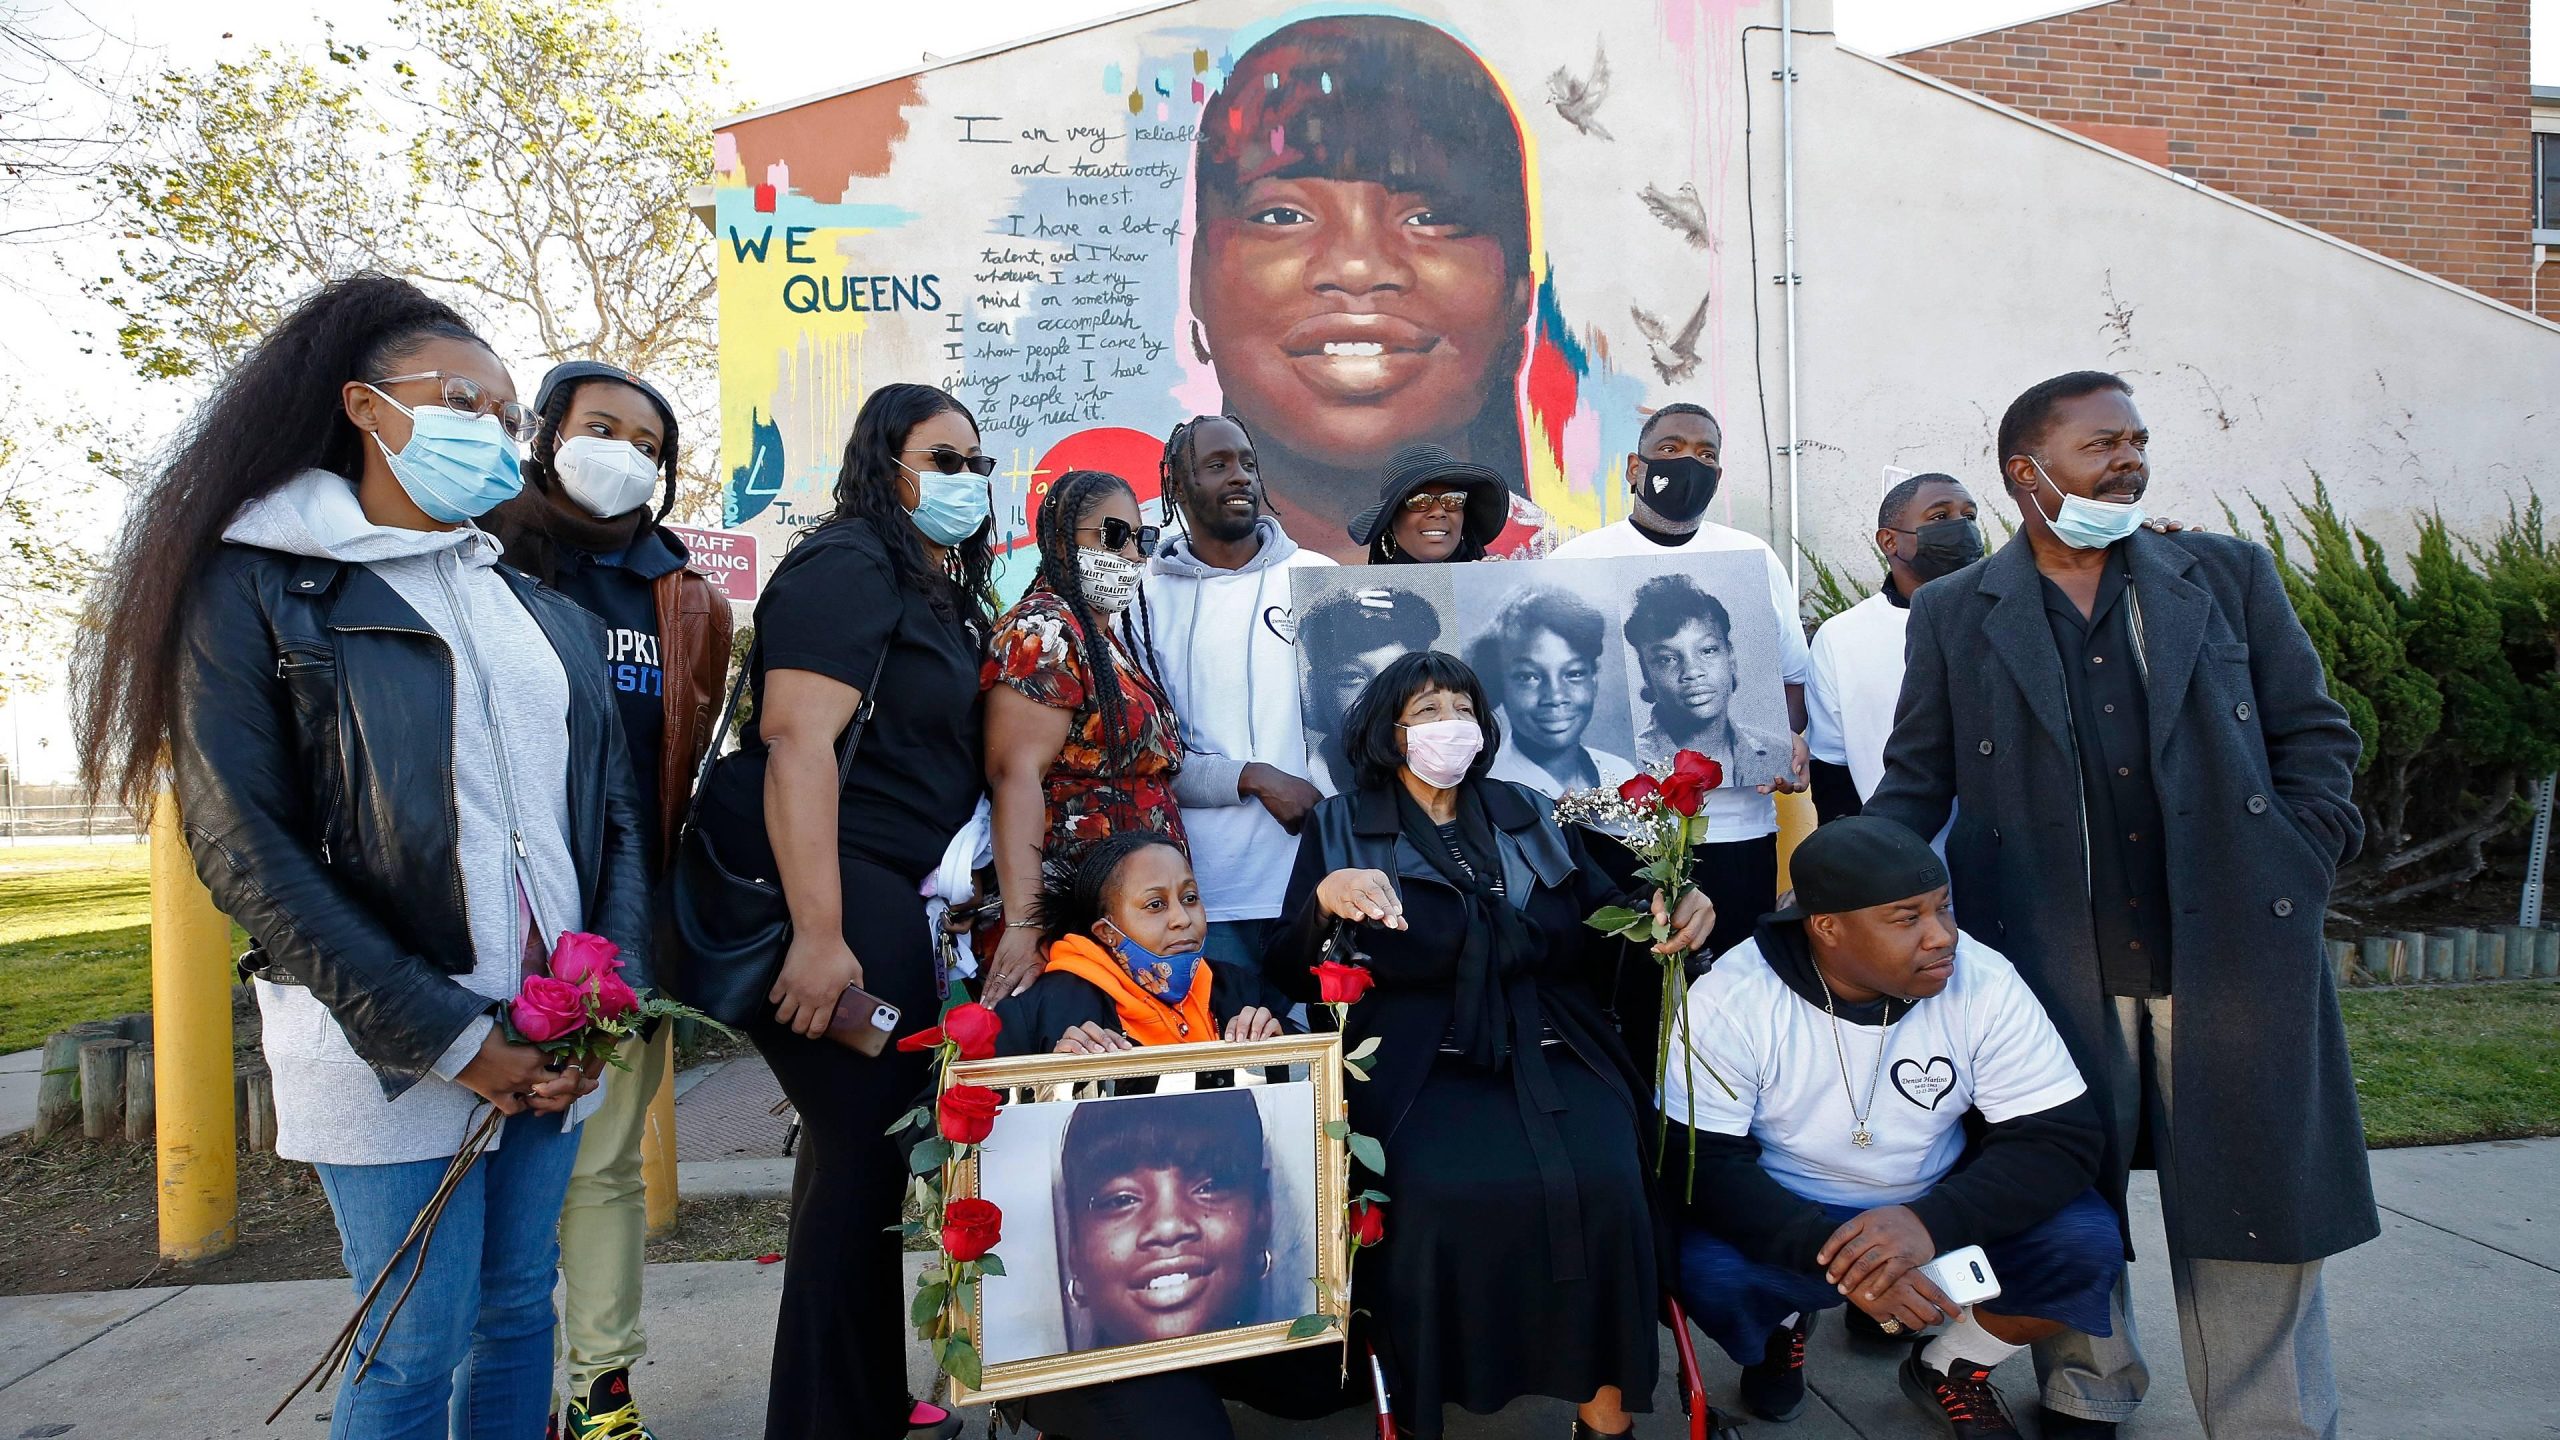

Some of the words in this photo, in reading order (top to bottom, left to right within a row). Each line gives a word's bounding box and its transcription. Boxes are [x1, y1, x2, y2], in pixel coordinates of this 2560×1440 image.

[954, 116, 1012, 143] I
[1022, 127, 1059, 143] am
[1068, 126, 1126, 153] very
[1011, 155, 1061, 175] and
[1068, 156, 1182, 188] trustworthy
[1067, 185, 1132, 207] honest.
[1007, 215, 1025, 237] I
[1033, 214, 1081, 237] have
[1099, 224, 1112, 234] a
[1120, 216, 1158, 234] lot
[1162, 221, 1186, 245] of
[729, 225, 817, 263] WE
[1050, 244, 1079, 263] and
[783, 274, 942, 313] QUEENS
[974, 268, 1043, 283] whatever
[1048, 271, 1066, 285] I
[1074, 270, 1101, 284] set
[1102, 270, 1140, 293] my
[977, 292, 1020, 309] mind
[1041, 296, 1062, 307] on
[1071, 293, 1140, 307] something
[946, 313, 964, 332] I
[977, 320, 1011, 336] can
[1037, 309, 1142, 332] accomplish
[944, 343, 965, 360] I
[973, 341, 1020, 360] show
[1026, 336, 1071, 365] people
[1077, 334, 1095, 350] I
[1100, 336, 1136, 349] care
[1140, 332, 1170, 361] by
[942, 370, 1011, 395] giving
[1017, 359, 1066, 383] what
[1081, 360, 1096, 382] I
[1110, 357, 1149, 378] have
[977, 398, 1001, 415] to
[1009, 385, 1064, 412] people
[1074, 385, 1114, 402] who
[977, 413, 1035, 438] ctually
[1038, 404, 1079, 425] need
[1082, 401, 1105, 421] it.
[689, 551, 749, 570] RKING
[1080, 568, 1104, 579] UALITY
[1094, 559, 1127, 570] EQUALITY
[706, 570, 729, 585] LY
[1094, 584, 1128, 594] EQUALITY
[1082, 592, 1105, 603] ALITY
[608, 664, 662, 697] SIT
